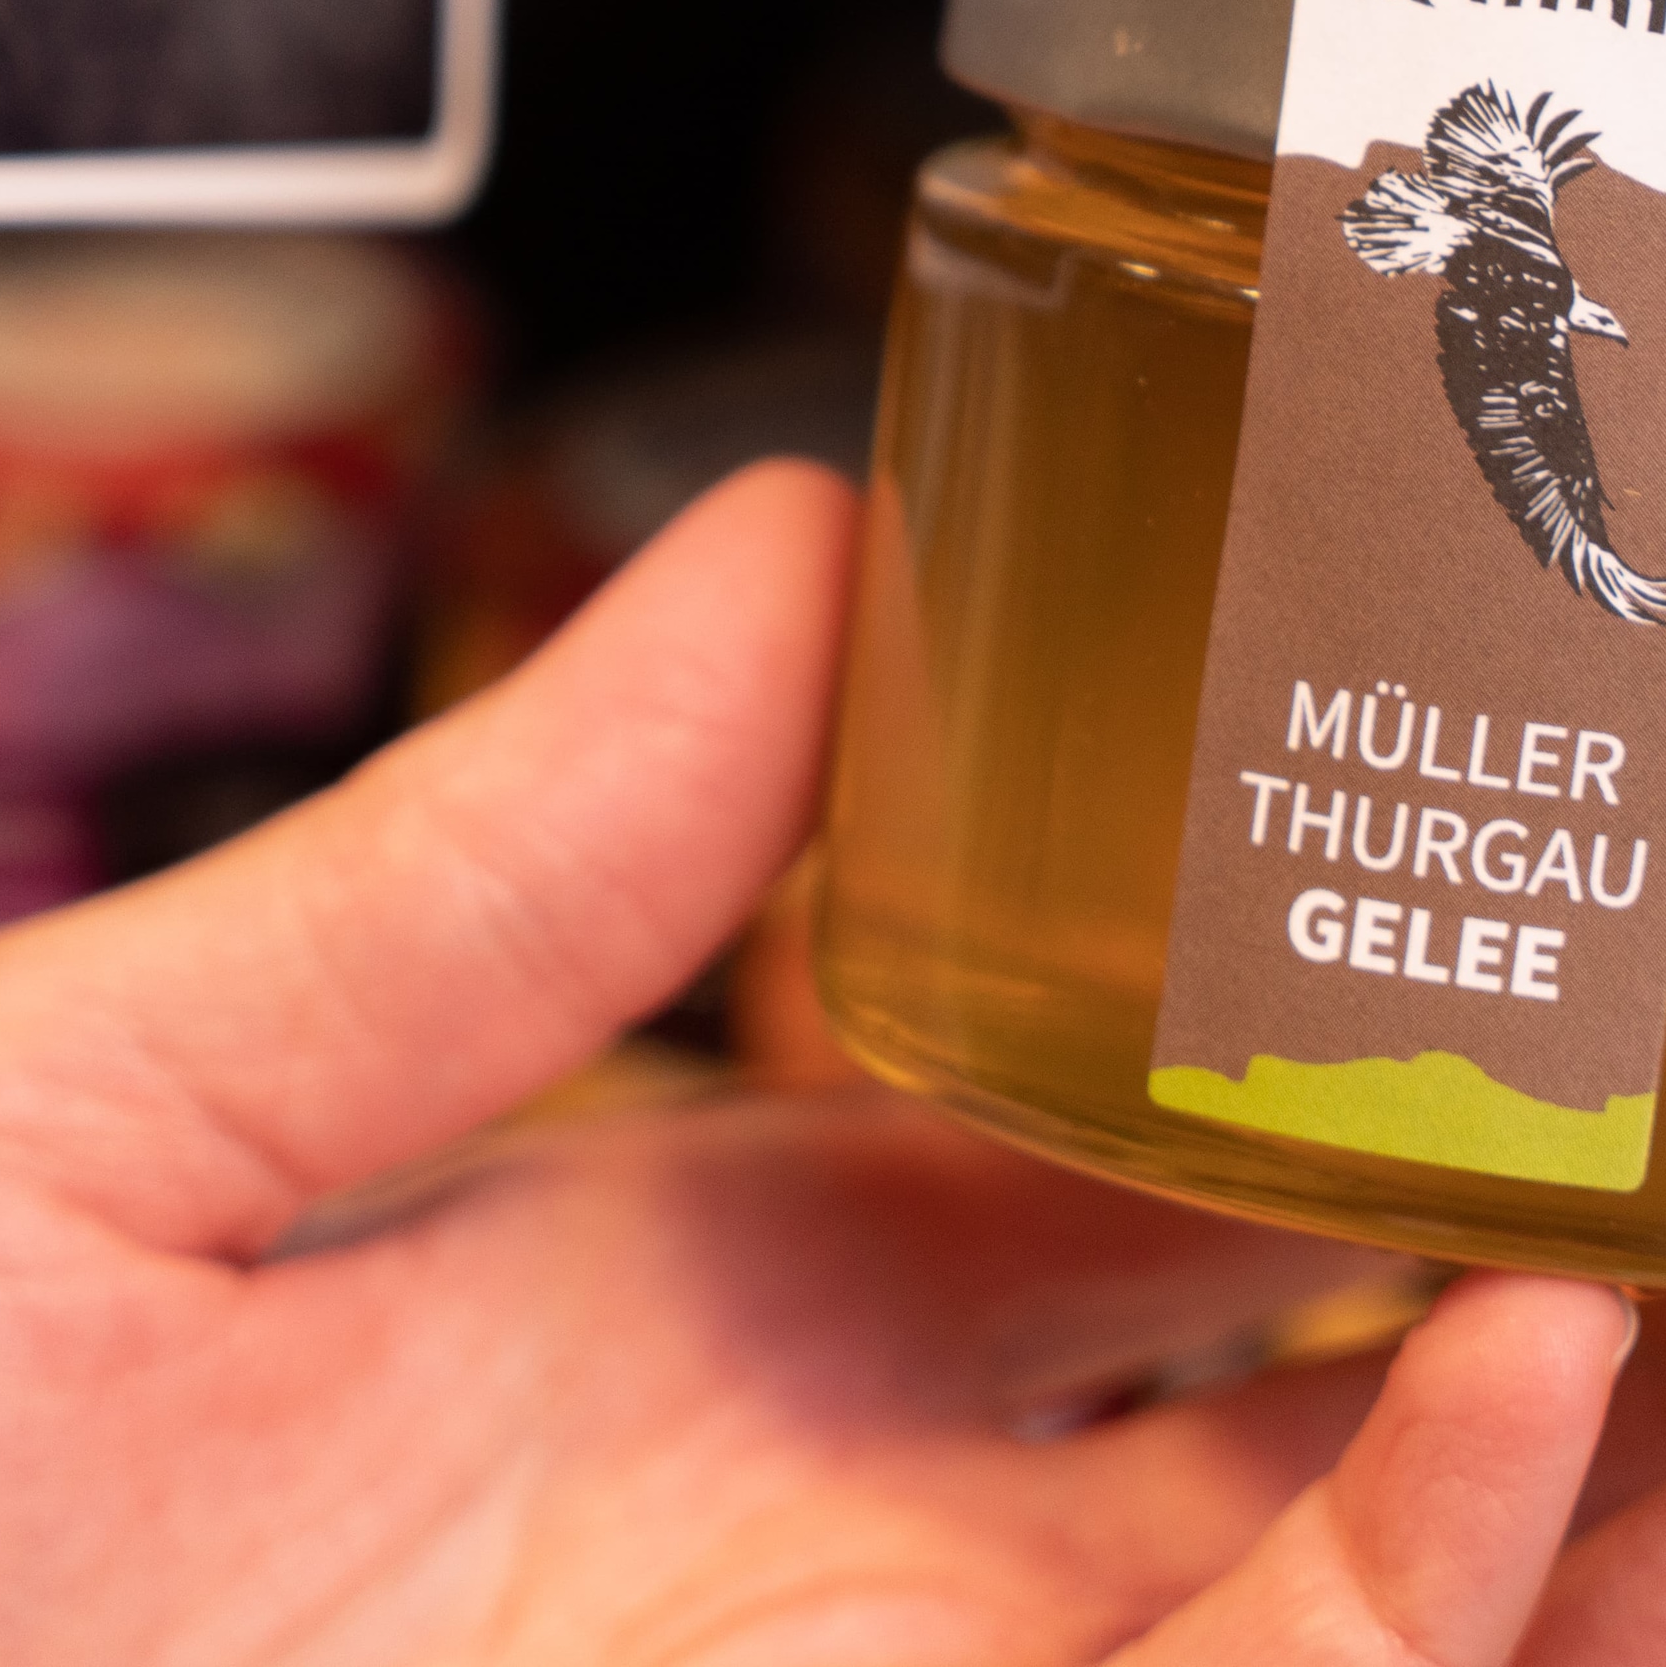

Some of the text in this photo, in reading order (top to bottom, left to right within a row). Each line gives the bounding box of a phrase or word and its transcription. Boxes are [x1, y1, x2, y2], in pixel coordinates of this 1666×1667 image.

[1285, 679, 1627, 806] MÜLLER
[1239, 769, 1649, 911] THURGAU
[1287, 888, 1567, 1001] GELEE
